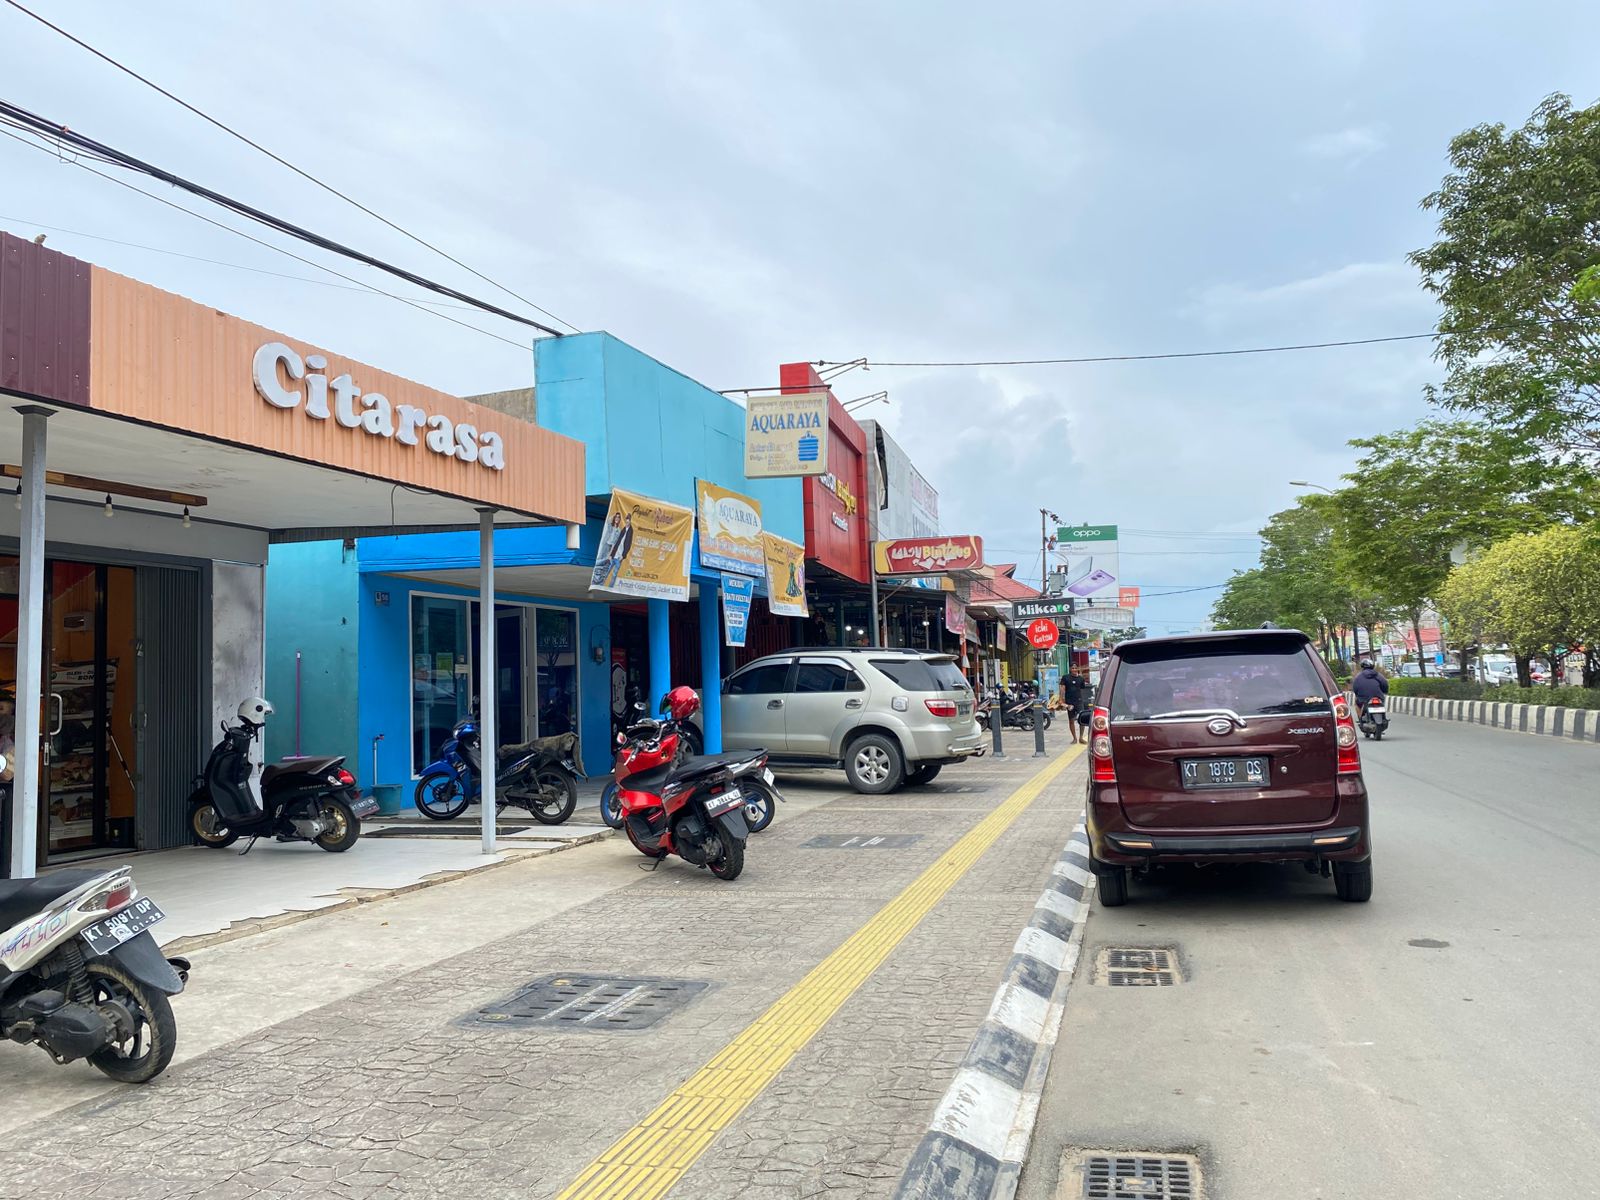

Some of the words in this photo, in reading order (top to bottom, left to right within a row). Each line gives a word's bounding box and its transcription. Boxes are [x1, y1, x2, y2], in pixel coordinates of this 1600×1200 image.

[252, 342, 505, 471] Citarasa
[750, 411, 821, 433] AQUARAYA
[719, 504, 758, 527] AQUARAYA
[1073, 529, 1101, 538] oppo
[1017, 602, 1071, 616] klikcare
[1287, 727, 1325, 735] XENIA
[1184, 763, 1198, 777] KT
[1208, 761, 1236, 777] 1878
[1246, 760, 1262, 775] QS
[85, 925, 103, 942] KT
[106, 910, 134, 931] 5097
[135, 899, 152, 914] DP
